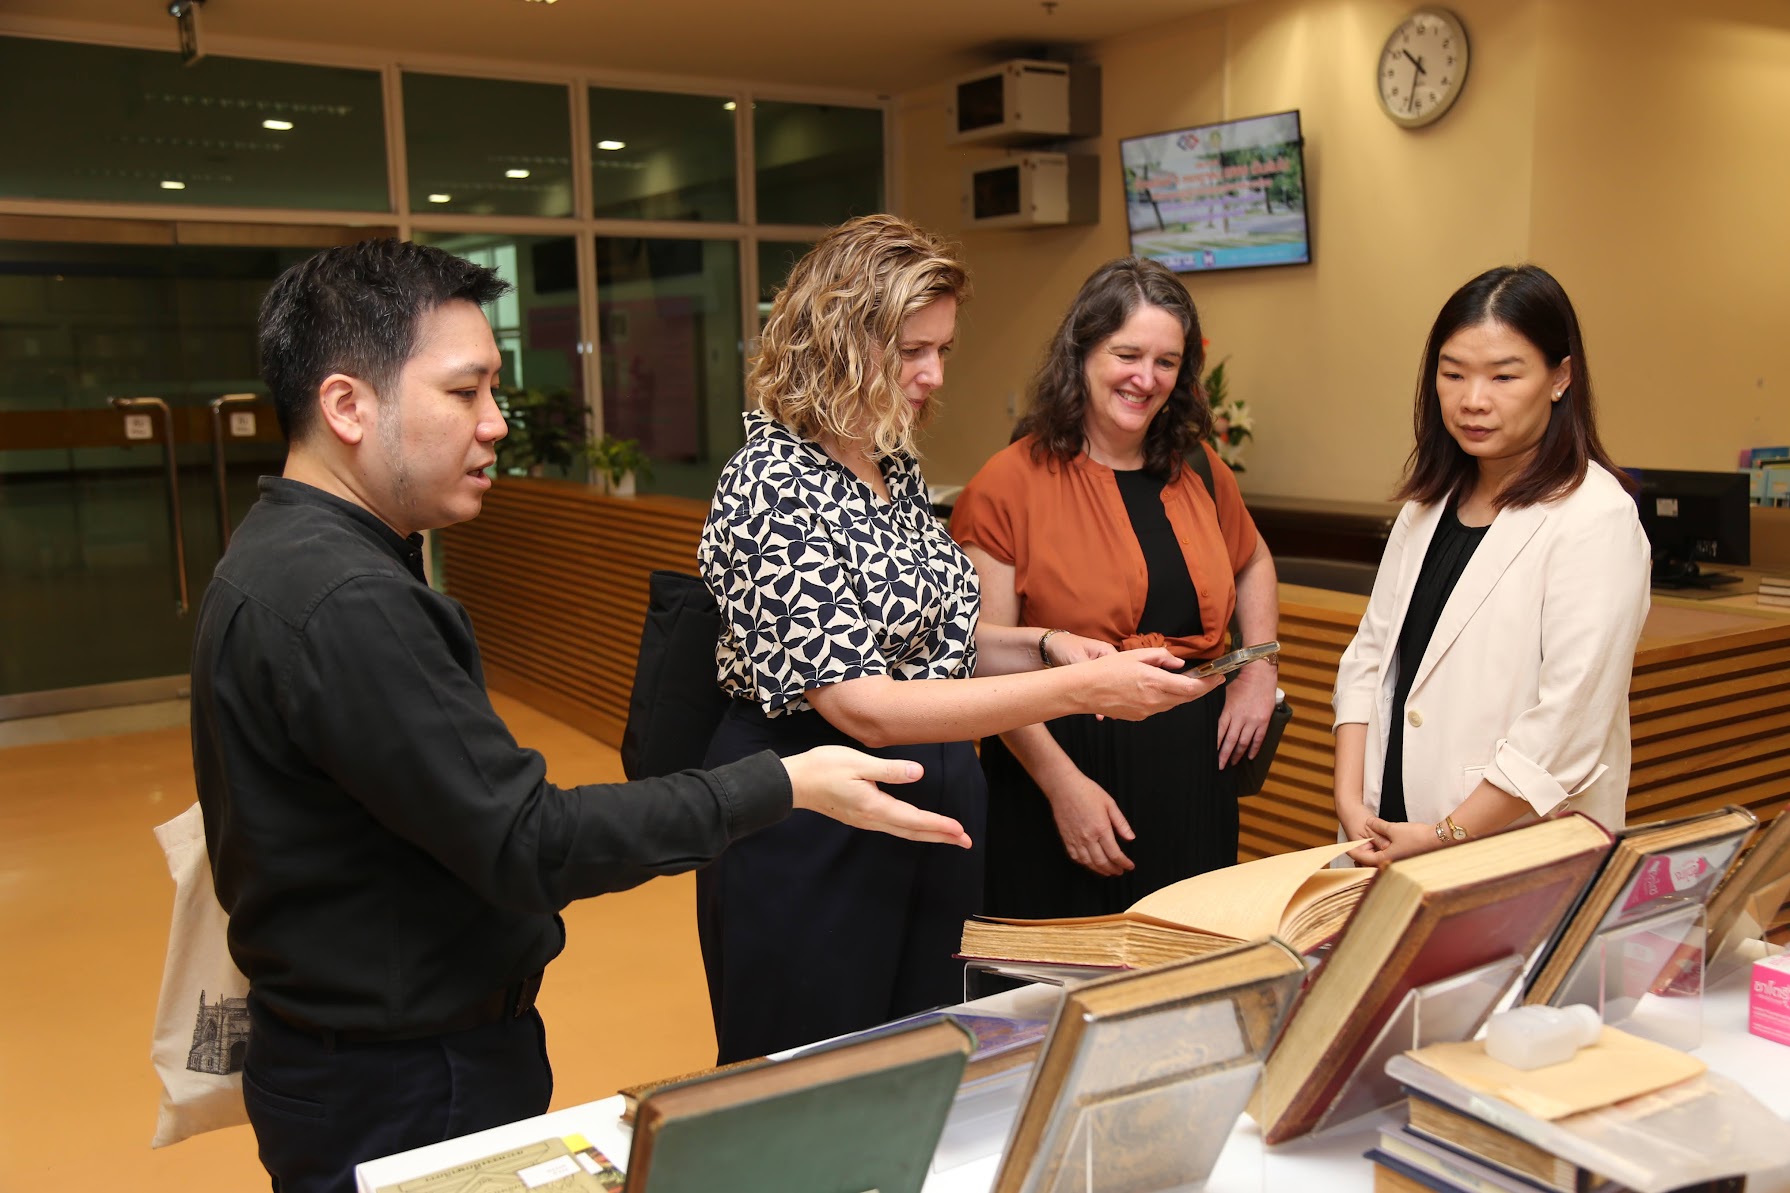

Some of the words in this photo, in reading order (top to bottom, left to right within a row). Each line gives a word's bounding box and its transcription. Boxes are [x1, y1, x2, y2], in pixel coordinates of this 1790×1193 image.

[1442, 38, 1449, 49] 2
[1447, 55, 1453, 66] 3
[1440, 76, 1447, 86] 4
[1429, 92, 1436, 102] 5
